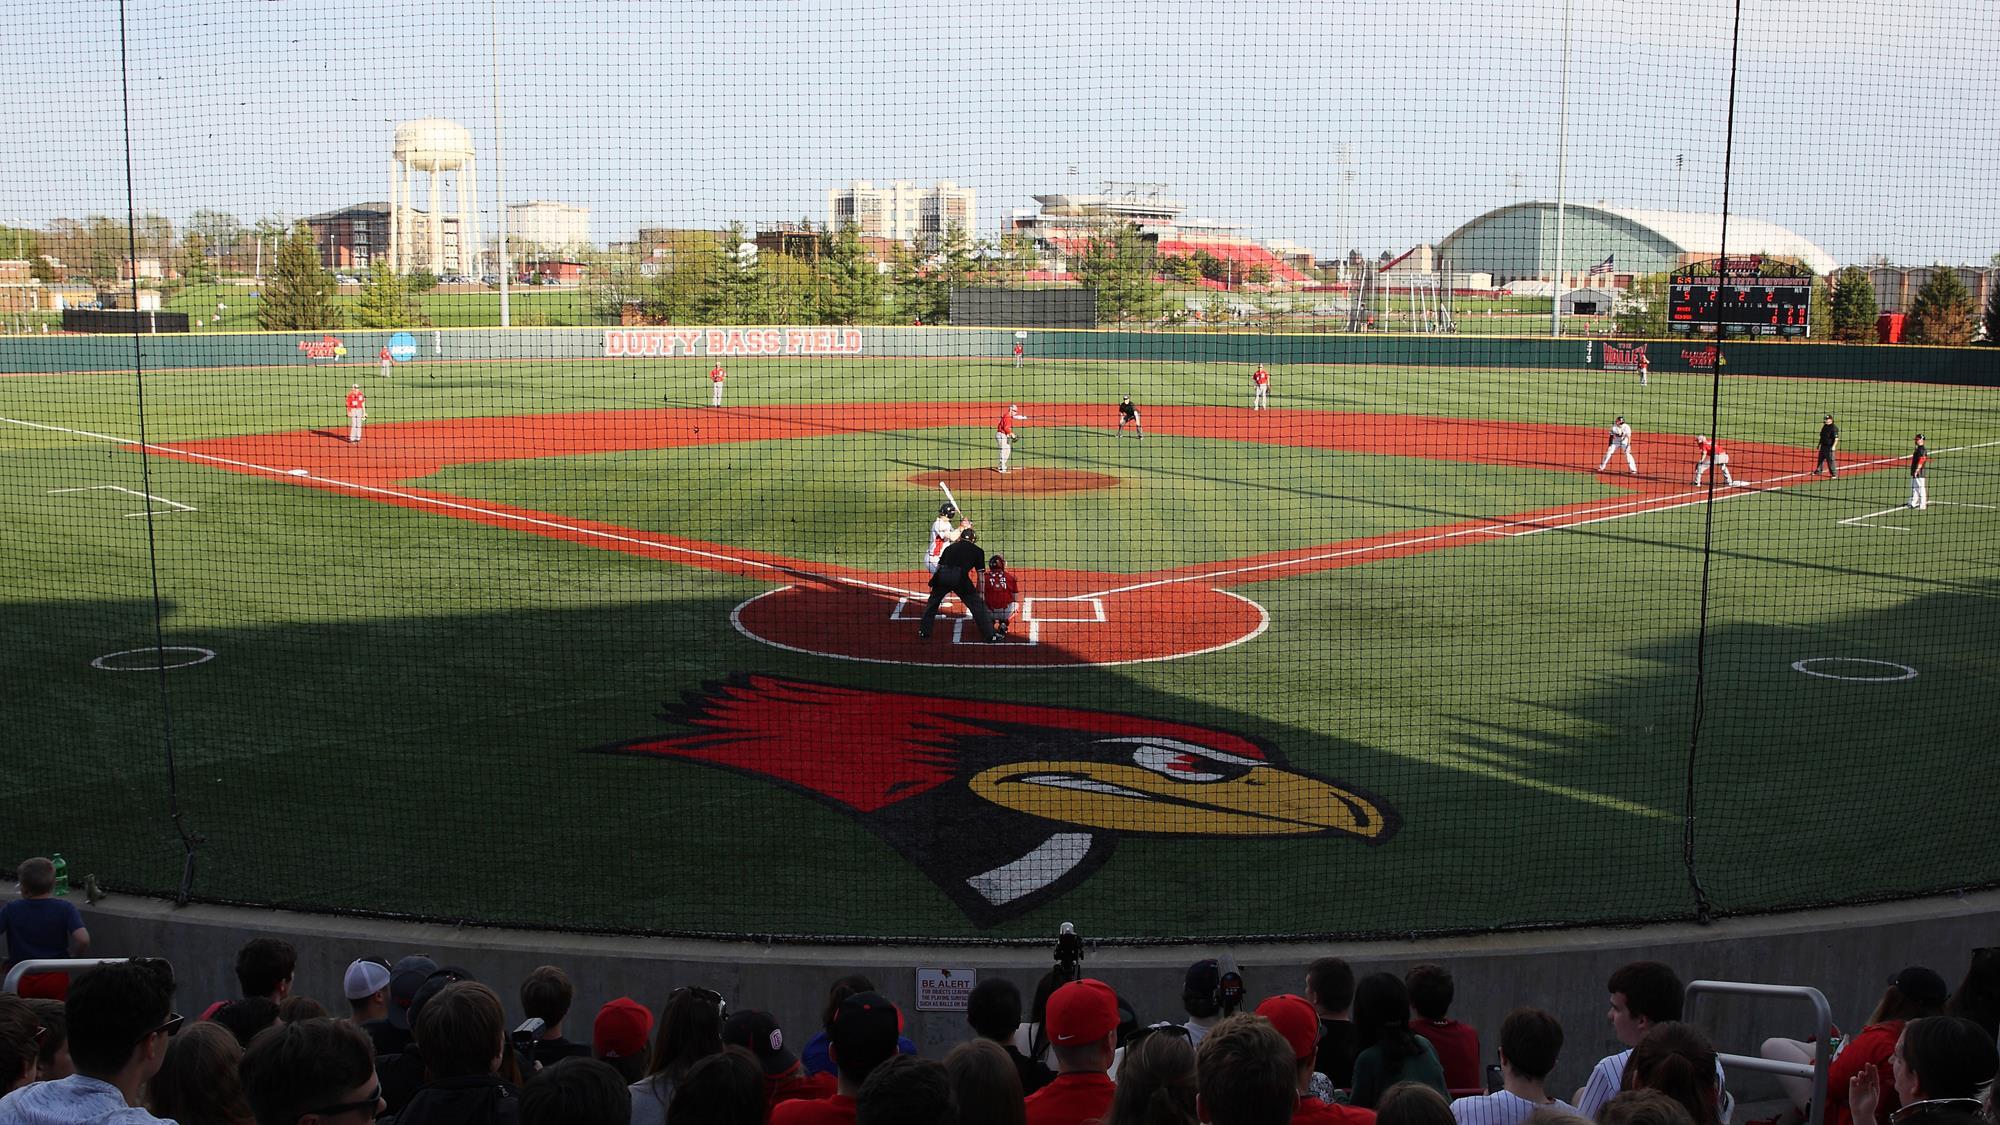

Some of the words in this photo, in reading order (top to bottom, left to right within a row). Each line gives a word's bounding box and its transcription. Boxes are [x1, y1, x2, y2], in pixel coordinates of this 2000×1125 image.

[1758, 278, 1810, 286] UNIVERSITY
[605, 330, 702, 356] DUFFY
[706, 330, 780, 355] BASS
[785, 328, 863, 354] FIELD
[1603, 342, 1648, 364] VALLEY
[922, 980, 935, 988] BE
[938, 980, 970, 988] ALERT
